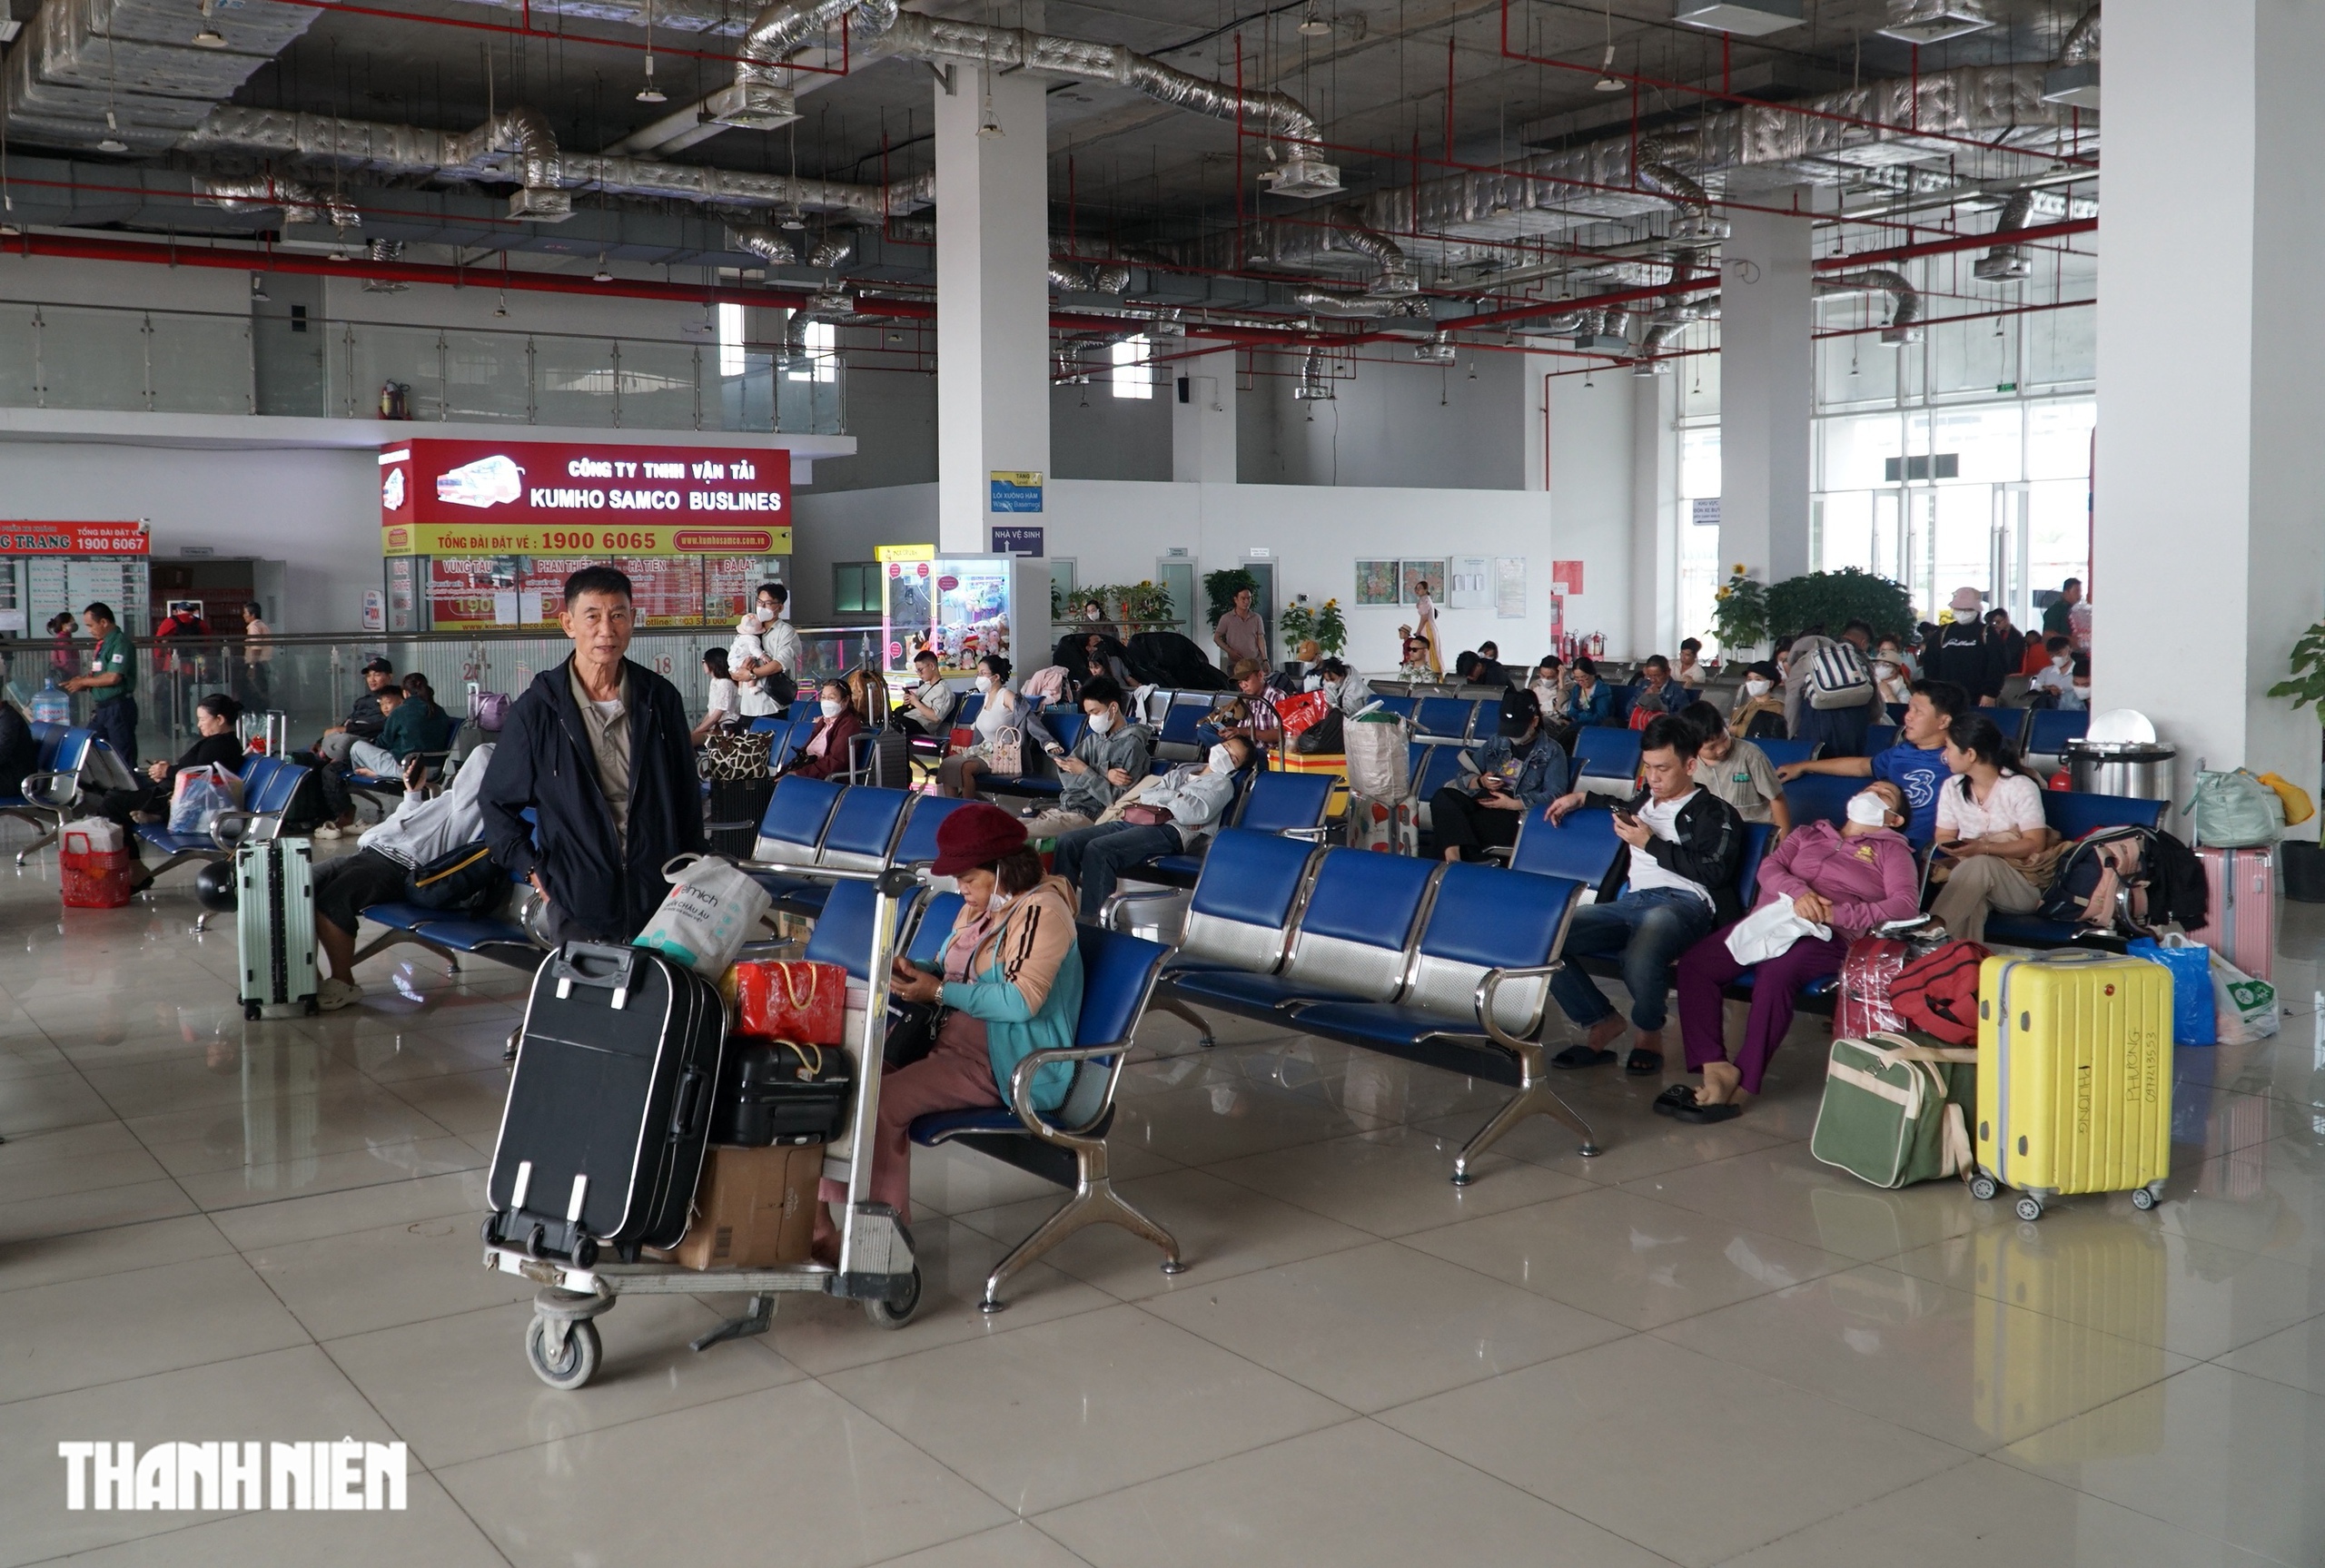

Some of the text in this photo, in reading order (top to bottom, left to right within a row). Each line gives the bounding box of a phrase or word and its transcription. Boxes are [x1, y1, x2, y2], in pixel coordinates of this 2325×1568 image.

[568, 457, 756, 485] CÔNG TY TNHH VẬN TẢI
[530, 488, 781, 511] KUMHO SAMCO BUSLINES
[15, 534, 71, 549] TRANG
[77, 537, 144, 549] 1900 6067
[438, 531, 467, 549] TỔNG
[470, 533, 489, 549] ĐÀI
[492, 536, 514, 552] ĐẶT
[517, 534, 529, 549] VÉ
[541, 532, 595, 549] 1900
[602, 532, 657, 549] 6065
[680, 535, 766, 546] www.kumhosamco.com.vn
[994, 529, 1011, 538] NHÀ
[1012, 529, 1023, 540] VỆ
[442, 557, 493, 574] VŨNG TÀU
[537, 559, 565, 573] PHAN
[628, 557, 667, 573] HÀ TIÊN
[724, 556, 737, 573] ĐÀ
[654, 656, 672, 675] 18
[680, 883, 718, 908] elmich
